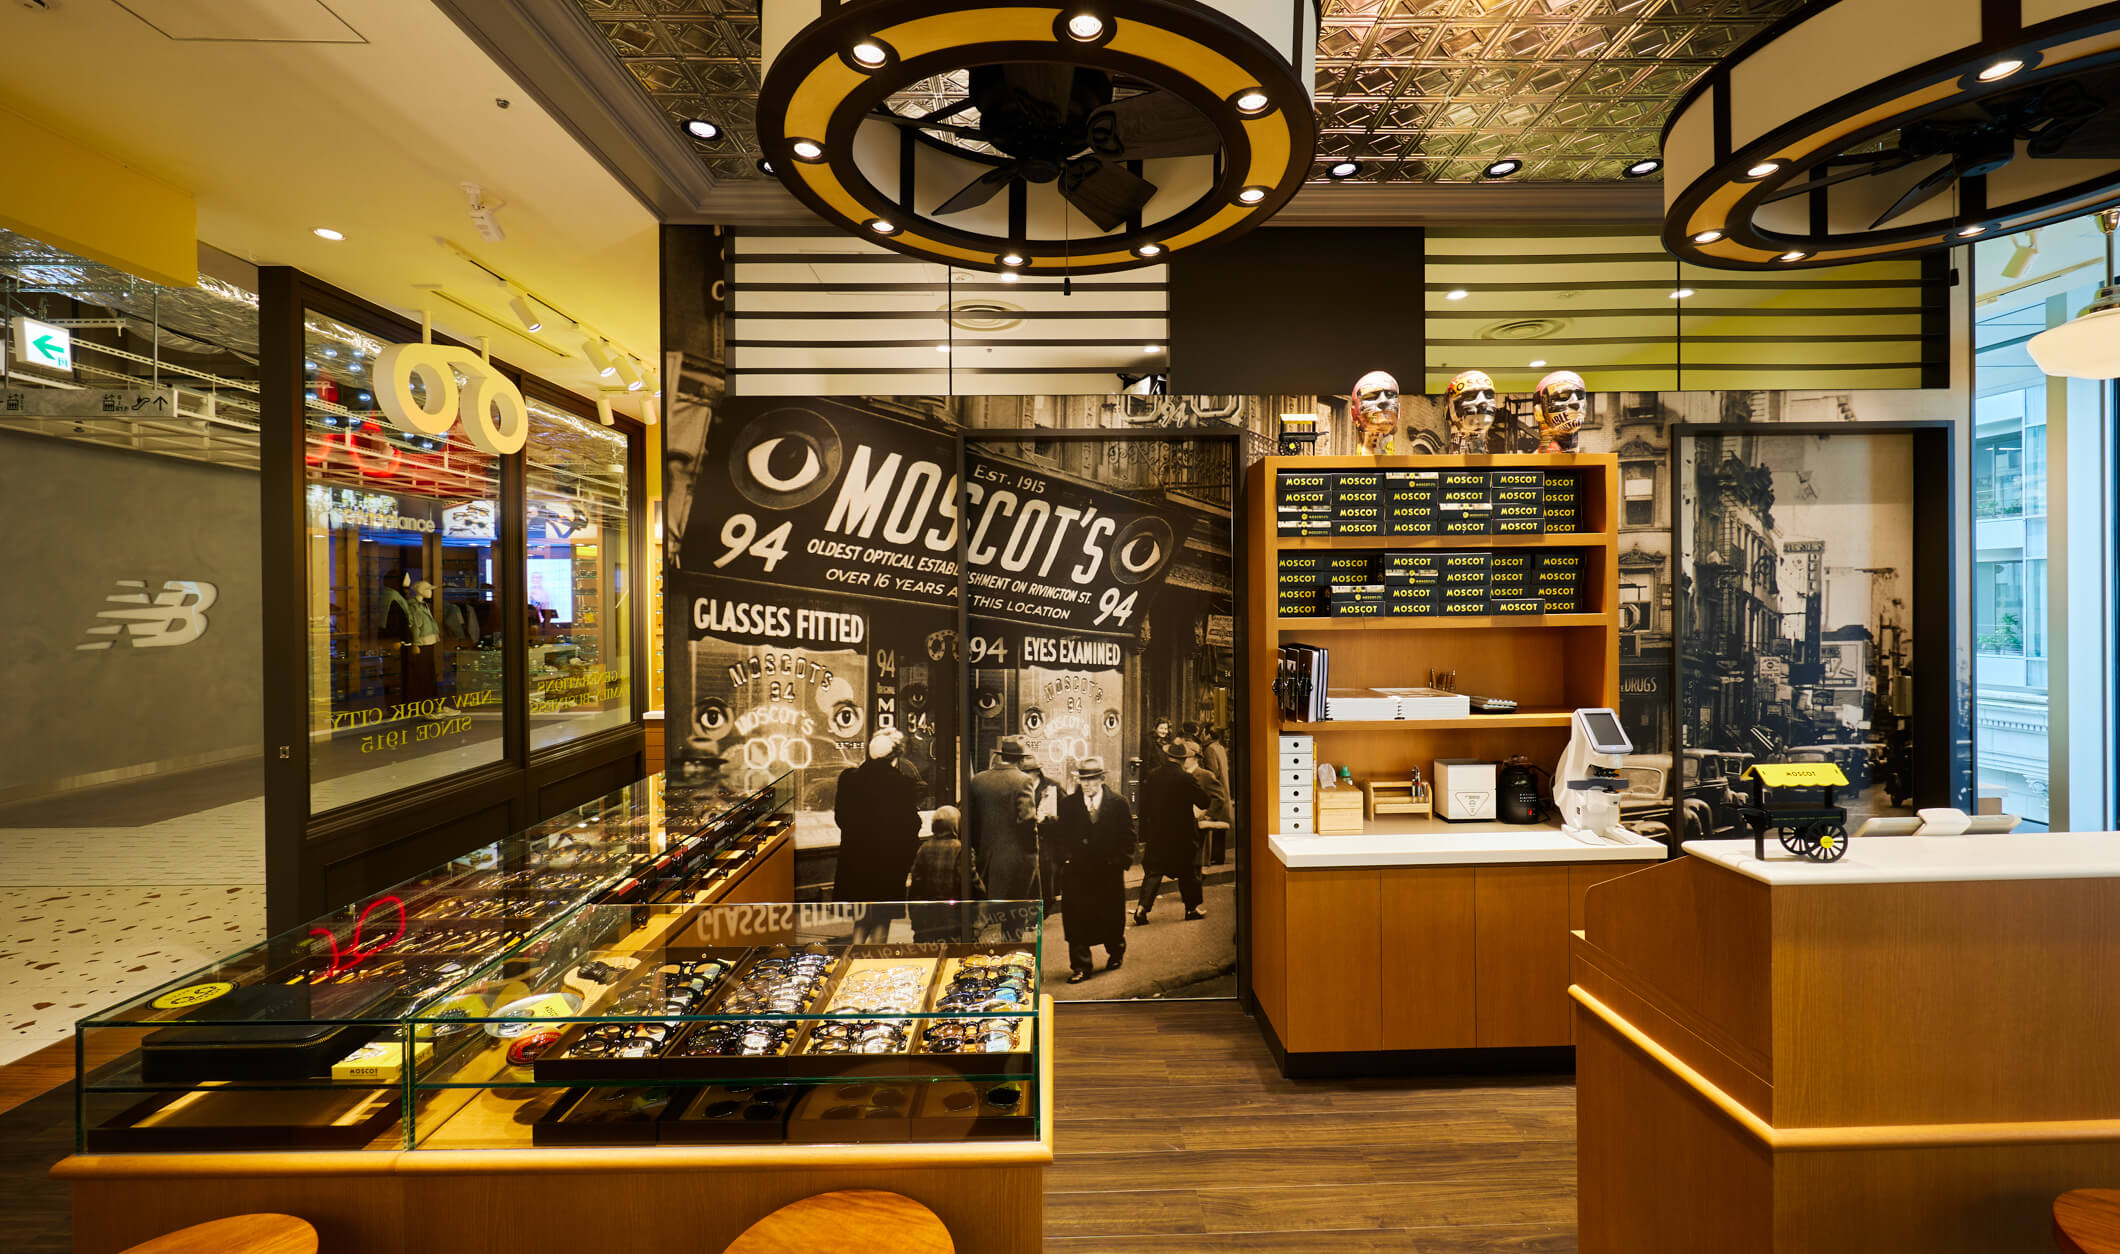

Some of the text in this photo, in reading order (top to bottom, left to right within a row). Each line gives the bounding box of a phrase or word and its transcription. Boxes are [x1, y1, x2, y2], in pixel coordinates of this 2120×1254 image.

[1017, 475, 1046, 494] 1915
[1286, 478, 1324, 486] MOSCOT
[1340, 477, 1377, 485] MOSCOT
[1446, 476, 1484, 484] MOSCOT
[1500, 476, 1537, 484] MOSCOT
[1286, 493, 1324, 502] MOSCOT
[1340, 493, 1377, 501] MOSCOT
[1393, 493, 1431, 501] MOSCOT
[1446, 492, 1483, 500] MOSCOT
[1500, 492, 1537, 500] MOSCOT
[824, 444, 1116, 585] MOSCOT'S
[1340, 509, 1377, 517] MOSCOT
[1393, 508, 1431, 516] MOSCOT
[1501, 507, 1537, 515] MOSCOT
[1340, 524, 1377, 533] MOSCOT
[1394, 523, 1431, 532] MOSCOT
[1447, 523, 1484, 531] MOSCOT
[1500, 522, 1538, 531] MOSCOT
[713, 513, 793, 573] 94
[1279, 559, 1316, 567] MOSCOT
[1331, 559, 1368, 567] MOSCOT
[1393, 558, 1431, 566] MOSCOT
[1447, 557, 1484, 566] MOSCOT
[1544, 558, 1579, 566] MOSCOT
[807, 539, 863, 561] OLDEST
[864, 549, 914, 570] OPTICAL
[1011, 581, 1028, 593] ON
[1028, 583, 1076, 602] RIVINGTON
[1076, 592, 1091, 604] ST.
[1279, 575, 1316, 583] MOSCOT
[1331, 575, 1368, 583] MOSCOT
[1447, 573, 1484, 582] MOSCOT
[1539, 573, 1576, 581] MOSCOT
[826, 568, 870, 586] OVER
[874, 572, 890, 588] 16
[895, 577, 945, 596] YEARS
[973, 594, 1004, 610] THIS
[1007, 601, 1071, 620] LOCATION
[1279, 590, 1316, 599] MOSCOT
[1393, 589, 1431, 598] MOSCOT
[1446, 588, 1484, 597] MOSCOT
[1538, 587, 1575, 596] MOSCOT
[1093, 587, 1138, 628] 94
[1279, 606, 1316, 614] MOSCOT
[1340, 605, 1378, 614] MOSCOT
[1393, 604, 1431, 613] MOSCOT
[1446, 604, 1484, 613] MOSCOT
[1500, 603, 1538, 612] MOSCOT
[693, 597, 864, 643] GLASSES FITTED
[969, 636, 1008, 664] 94
[1024, 636, 1121, 667] EYES EXAMINED
[876, 649, 896, 679] 94
[728, 653, 834, 692] MOSCOT'S
[1043, 675, 1104, 704] MOSCOT'S
[1625, 677, 1656, 693] DRUGS
